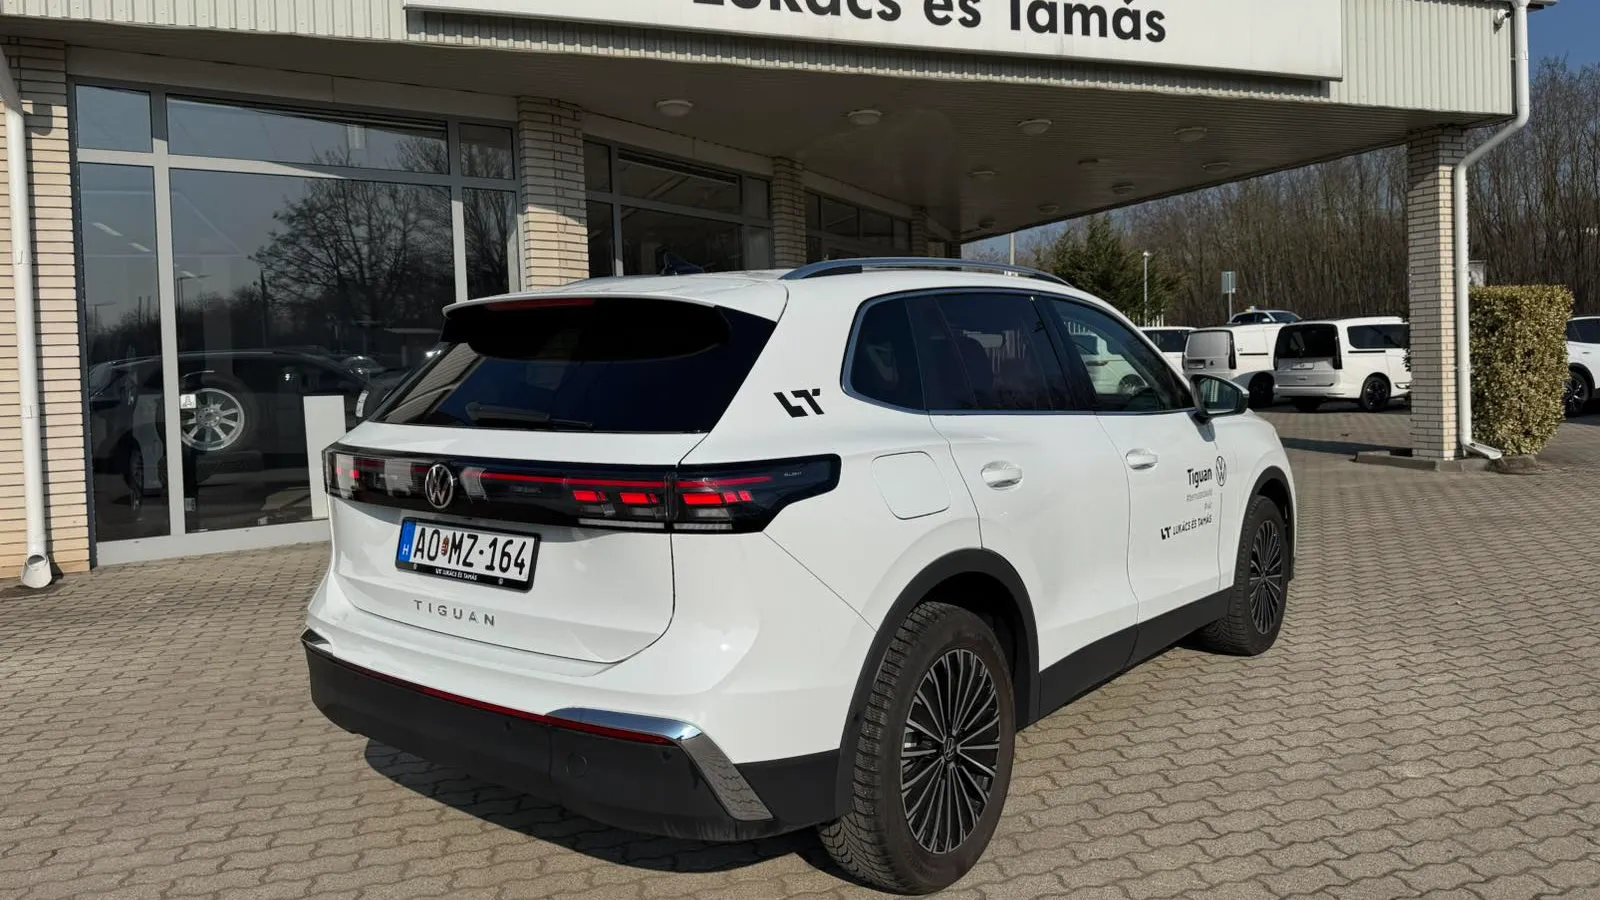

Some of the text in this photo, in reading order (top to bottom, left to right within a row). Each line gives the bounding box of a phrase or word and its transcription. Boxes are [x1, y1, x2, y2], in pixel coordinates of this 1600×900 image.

[1187, 468, 1213, 488] Tiguan
[402, 543, 410, 556] H
[413, 600, 495, 626] TIGUAN
